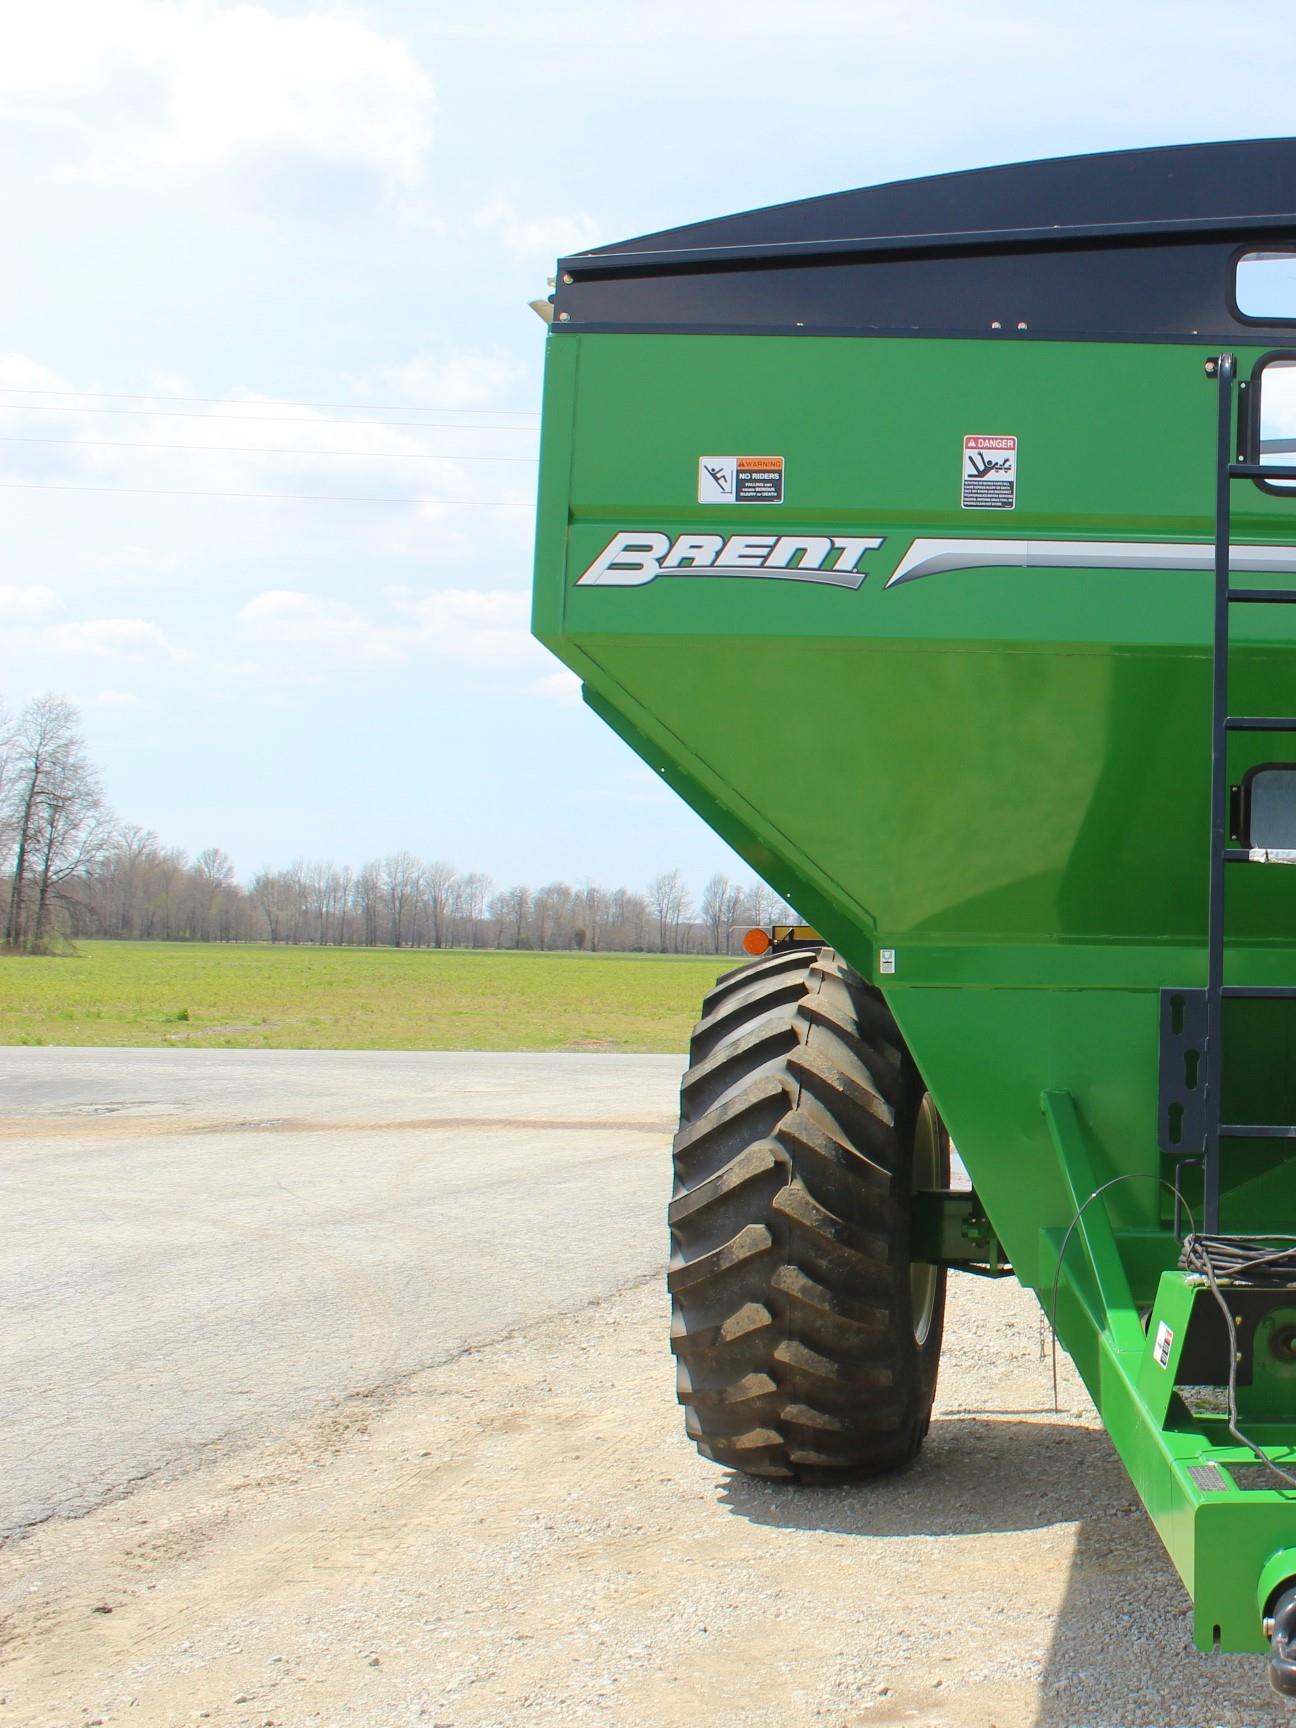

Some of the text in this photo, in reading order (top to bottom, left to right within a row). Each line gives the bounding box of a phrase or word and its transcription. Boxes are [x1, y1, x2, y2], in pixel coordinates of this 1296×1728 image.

[977, 438, 1014, 449] DANGER
[745, 460, 781, 468] WARNING
[739, 472, 780, 480] NO RIDERS
[573, 530, 888, 587] BRENT
